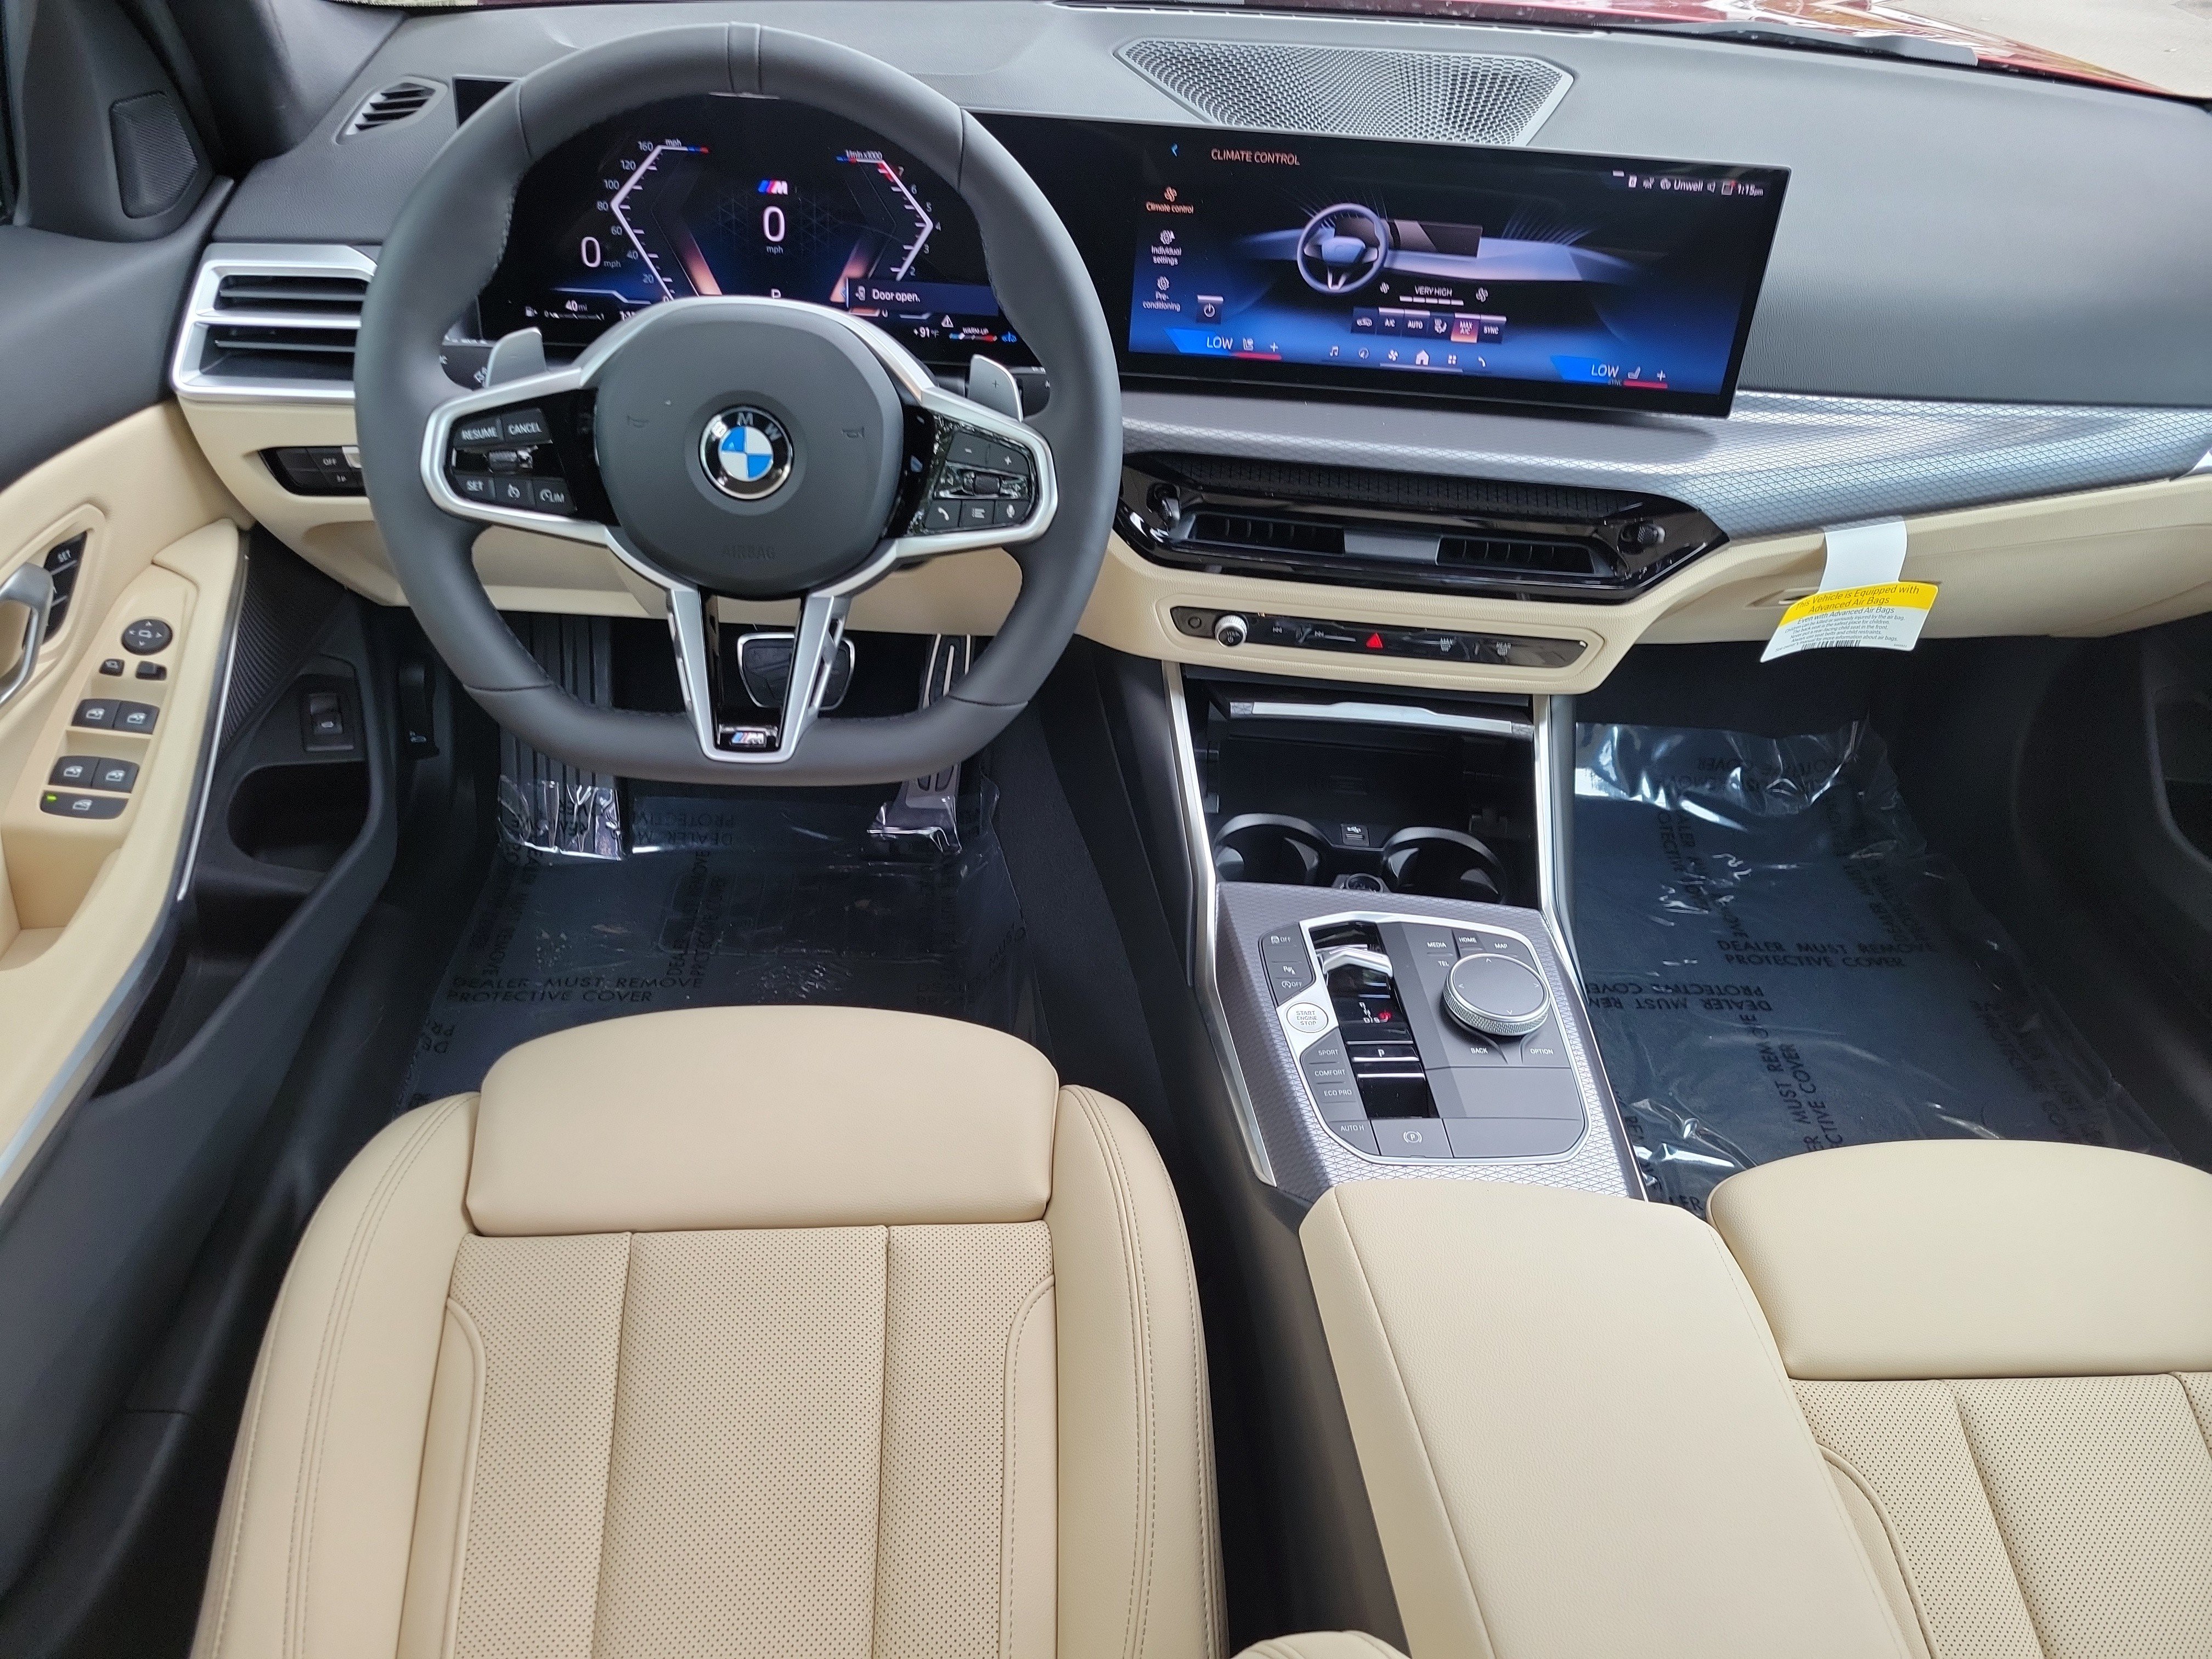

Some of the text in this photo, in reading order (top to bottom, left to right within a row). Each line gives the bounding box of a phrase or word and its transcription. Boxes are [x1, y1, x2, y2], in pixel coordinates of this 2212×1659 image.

[638, 141, 653, 151] 160
[665, 138, 681, 147] mph
[1211, 148, 1300, 166] CLIMATE CONTROL
[620, 161, 636, 170] 120
[899, 166, 904, 176] 7
[605, 179, 619, 190] 100
[911, 185, 917, 194] 6
[1674, 178, 1703, 192] Unwell
[597, 201, 608, 211] 80
[927, 203, 932, 213] 5
[1146, 201, 1194, 214] Climate control
[763, 206, 786, 242] 0
[935, 222, 941, 231] 4
[612, 226, 622, 235] 60
[581, 236, 601, 268] 0
[627, 251, 638, 260] 40
[766, 245, 783, 255] mph
[924, 245, 929, 255] 3
[1152, 246, 1182, 257] Individual
[603, 259, 621, 269] mph
[1153, 255, 1178, 266] settings
[911, 267, 916, 276] 2
[643, 275, 654, 284] 20
[771, 289, 781, 300] P
[872, 289, 920, 303] Door open.
[1155, 292, 1169, 301] Pre-
[1415, 285, 1452, 297] VERY HIGH
[1143, 300, 1181, 312] conditioning
[1385, 318, 1395, 328] A/C
[1408, 320, 1423, 329] AUTO
[1460, 320, 1472, 329] MAX
[1483, 326, 1499, 335] SYNC
[1206, 337, 1233, 350] LOW
[1592, 364, 1619, 377] LOW
[461, 427, 498, 440] RESUME
[508, 422, 543, 435] CANCEL
[323, 458, 337, 466] OFF
[466, 480, 483, 492] SET
[58, 550, 71, 563] SET
[1797, 600, 1810, 611] This
[1813, 592, 1842, 603] Vehicle
[1854, 585, 1898, 599] Equipped
[1899, 585, 1919, 594] with
[1809, 600, 1850, 614] Advanced
[1867, 596, 1890, 606] Bags
[1797, 616, 1813, 624] Even
[1829, 607, 1864, 617] Advanced
[1875, 606, 1895, 615] Bags
[1717, 940, 1785, 953] DEALER
[1796, 942, 1847, 955] MUST
[1725, 953, 1907, 968] PROTECTIVE COVER
[452, 977, 704, 989] DEALER MUST REMOVE
[446, 990, 653, 1003] PROTECTIVE COVER
[1634, 997, 1689, 1011] MUST
[1699, 997, 1774, 1012] DEALER
